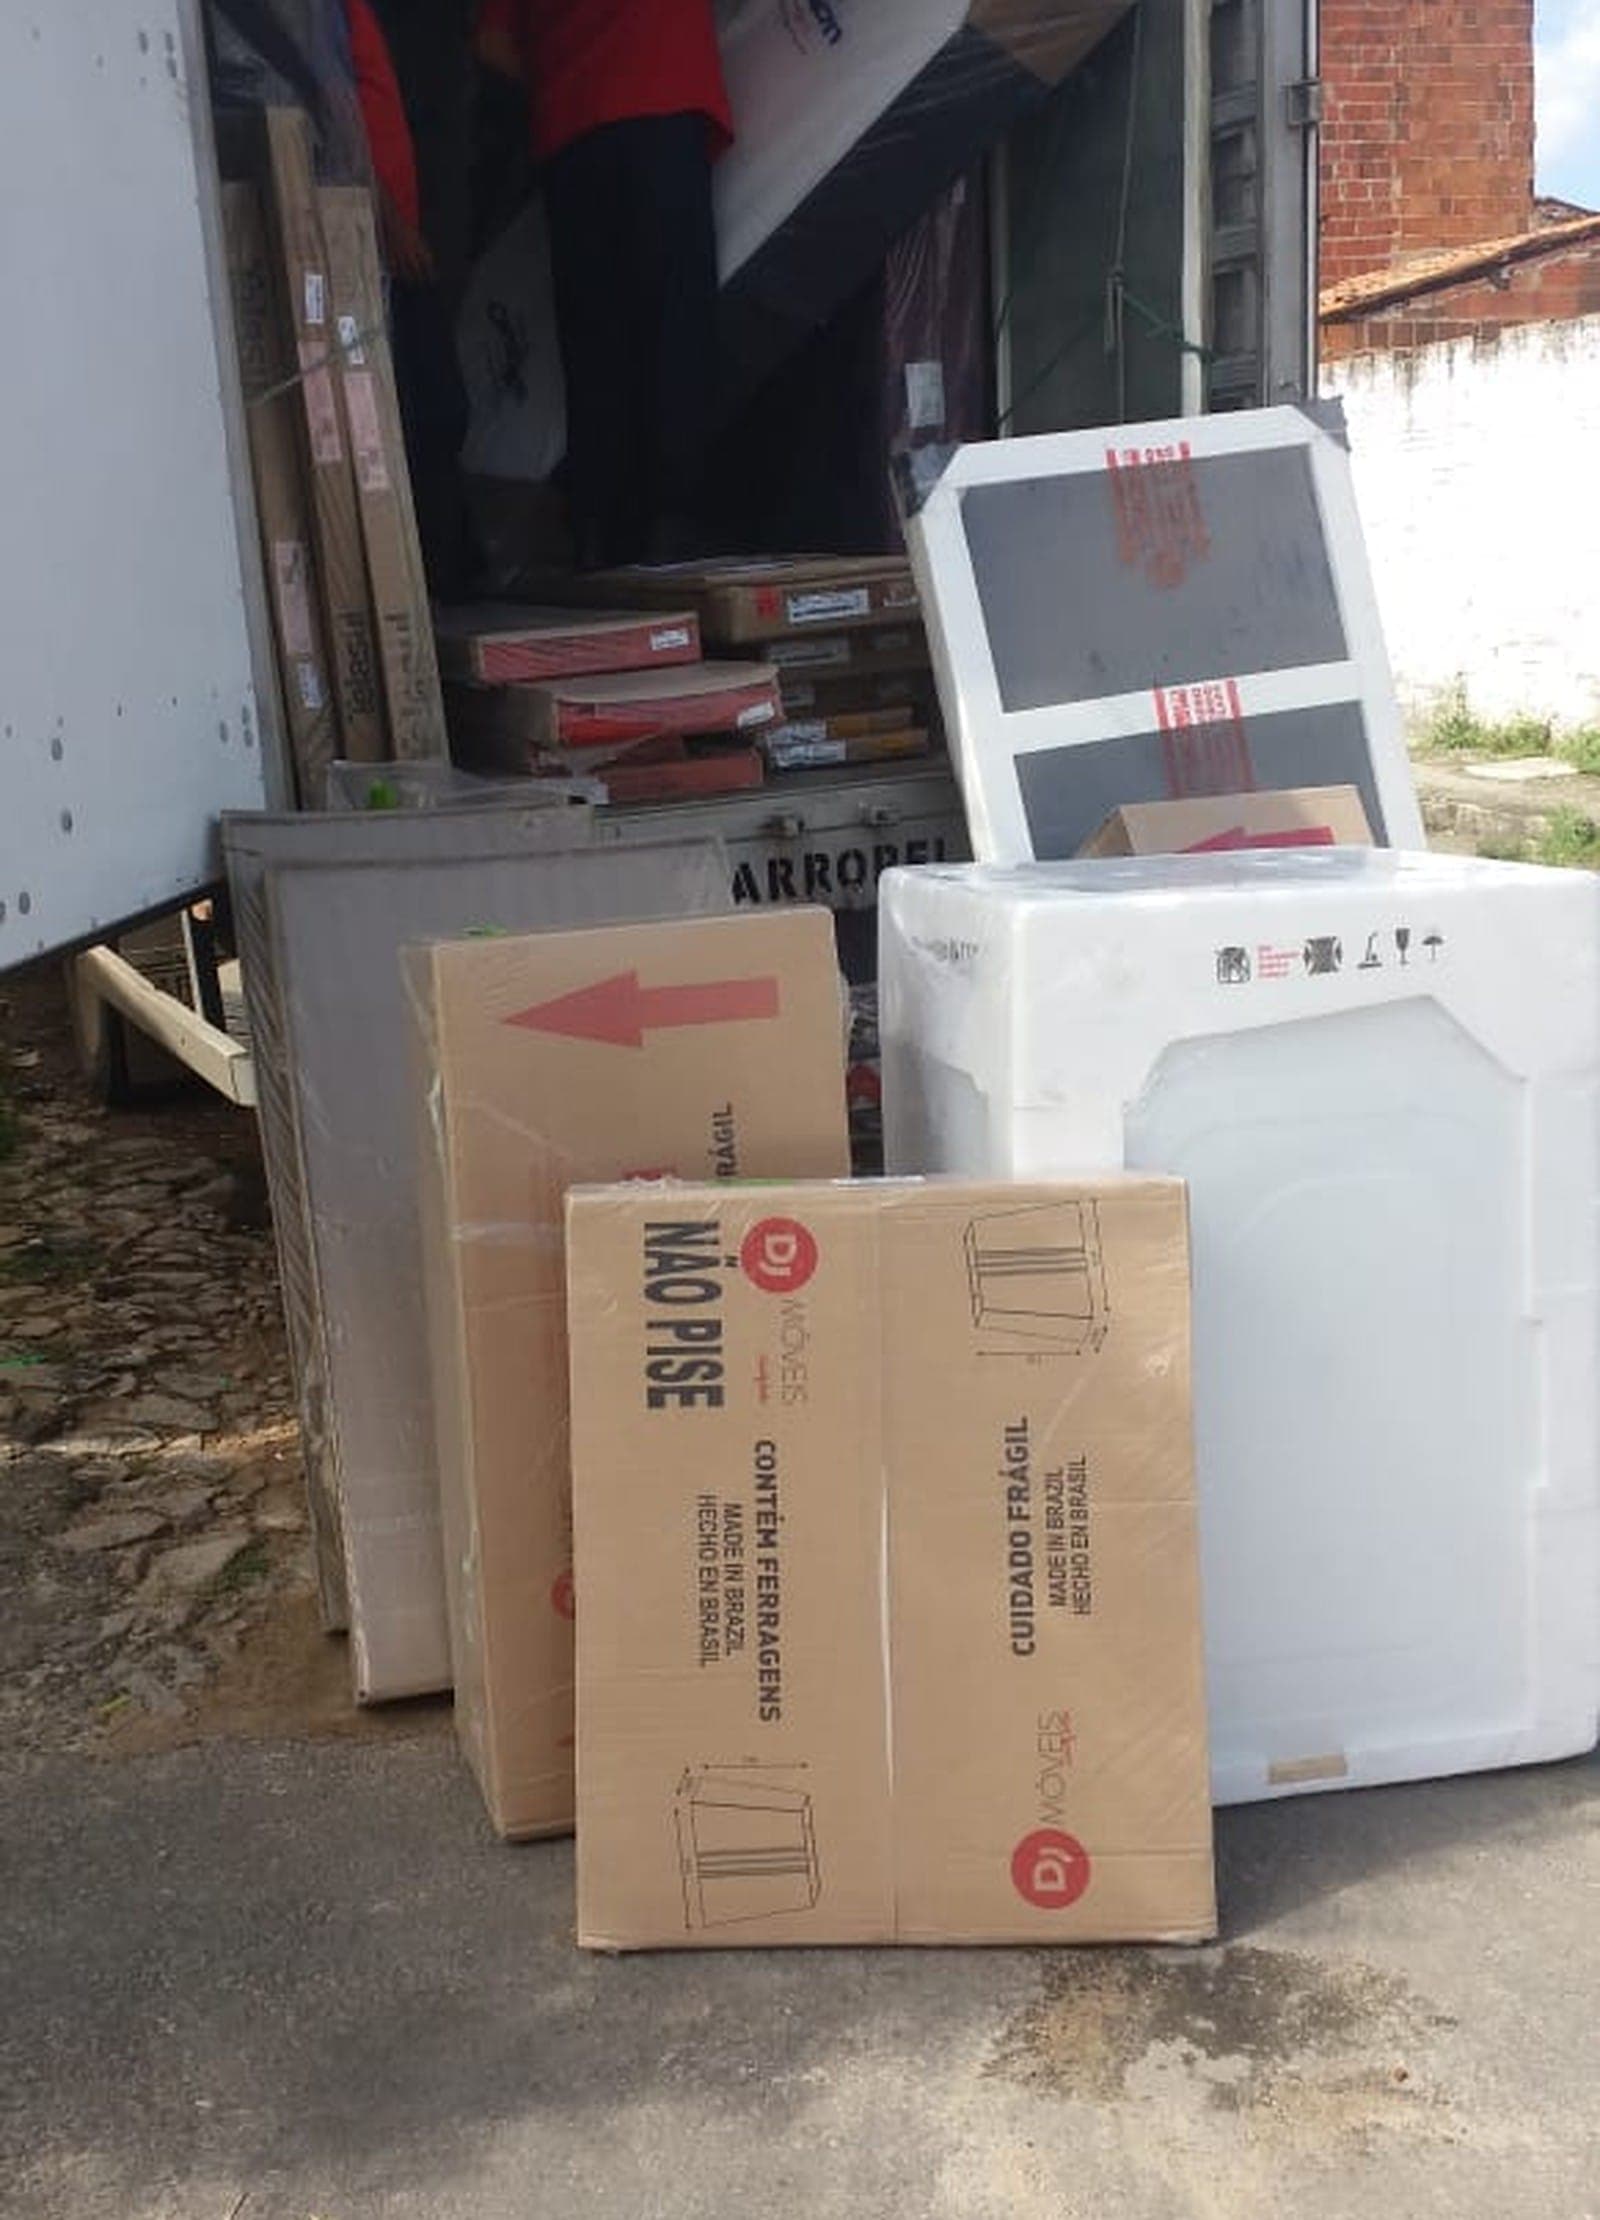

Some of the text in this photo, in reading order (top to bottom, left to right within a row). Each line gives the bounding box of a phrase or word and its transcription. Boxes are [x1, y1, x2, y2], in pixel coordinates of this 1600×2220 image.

[645, 1319, 725, 1409] PISE
[698, 1494, 720, 1669] HECHO EN BRASIL
[723, 1503, 745, 1657] MADE IN BRAZIL
[755, 1440, 785, 1722] CONTÉM FERRAGENS
[998, 1416, 1036, 1656] CUIDADO FRÁGIL
[1045, 1466, 1067, 1607] MADE IN BRAZIL
[1067, 1455, 1091, 1615] HECHO EN BRASIL
